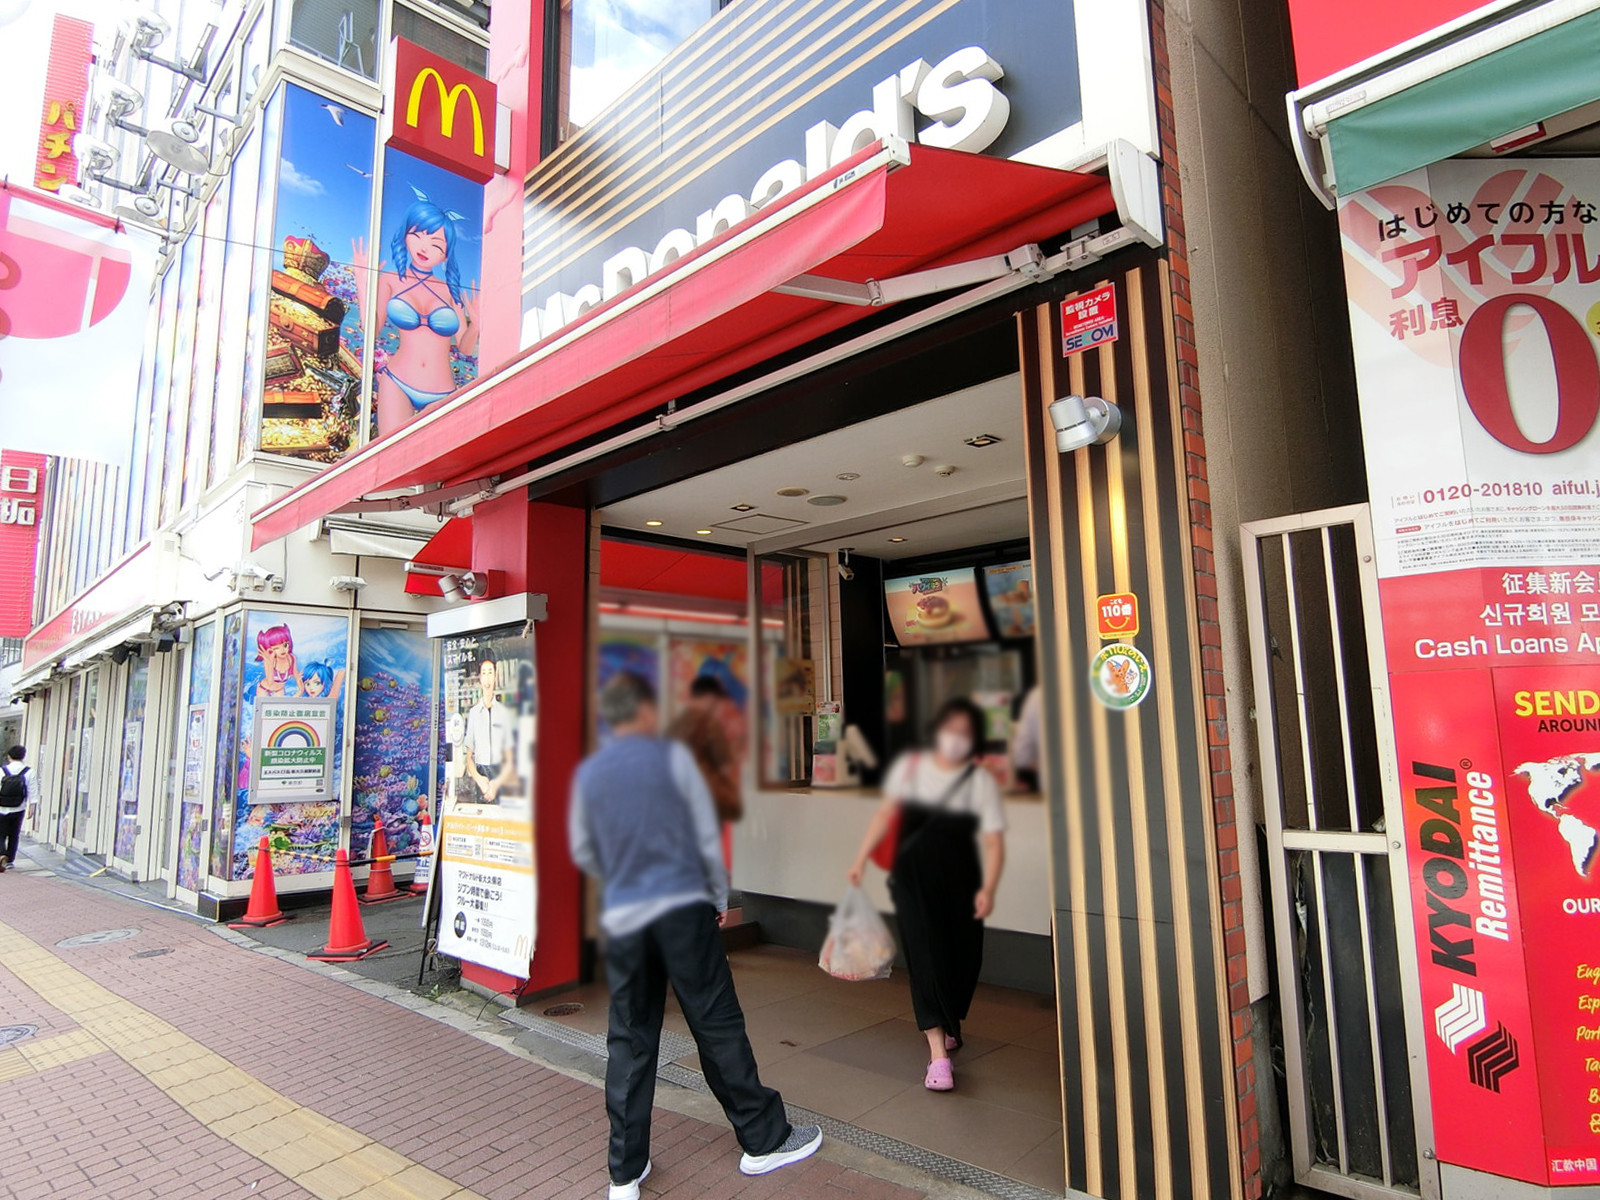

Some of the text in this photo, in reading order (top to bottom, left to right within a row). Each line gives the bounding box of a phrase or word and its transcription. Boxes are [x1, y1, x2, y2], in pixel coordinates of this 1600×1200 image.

[1378, 200, 1598, 242] はじめての方な
[1381, 233, 1600, 299] アイフル
[1065, 291, 1111, 315] 監視カメラ
[1066, 324, 1114, 351] SECOM
[1389, 293, 1600, 455] 利息 0
[1423, 482, 1543, 504] 0120-201810
[1502, 571, 1600, 595] 征集新会
[1101, 603, 1132, 618] 110番
[1479, 601, 1572, 627] 신규회원
[1415, 635, 1488, 659] Cash
[1496, 632, 1569, 655] Loans
[1514, 690, 1600, 717] SEND
[1537, 718, 1600, 733] AROUN
[1411, 761, 1477, 977] KYODAI
[1466, 771, 1510, 941] Remittance
[1552, 1158, 1598, 1173] 汇款中国
